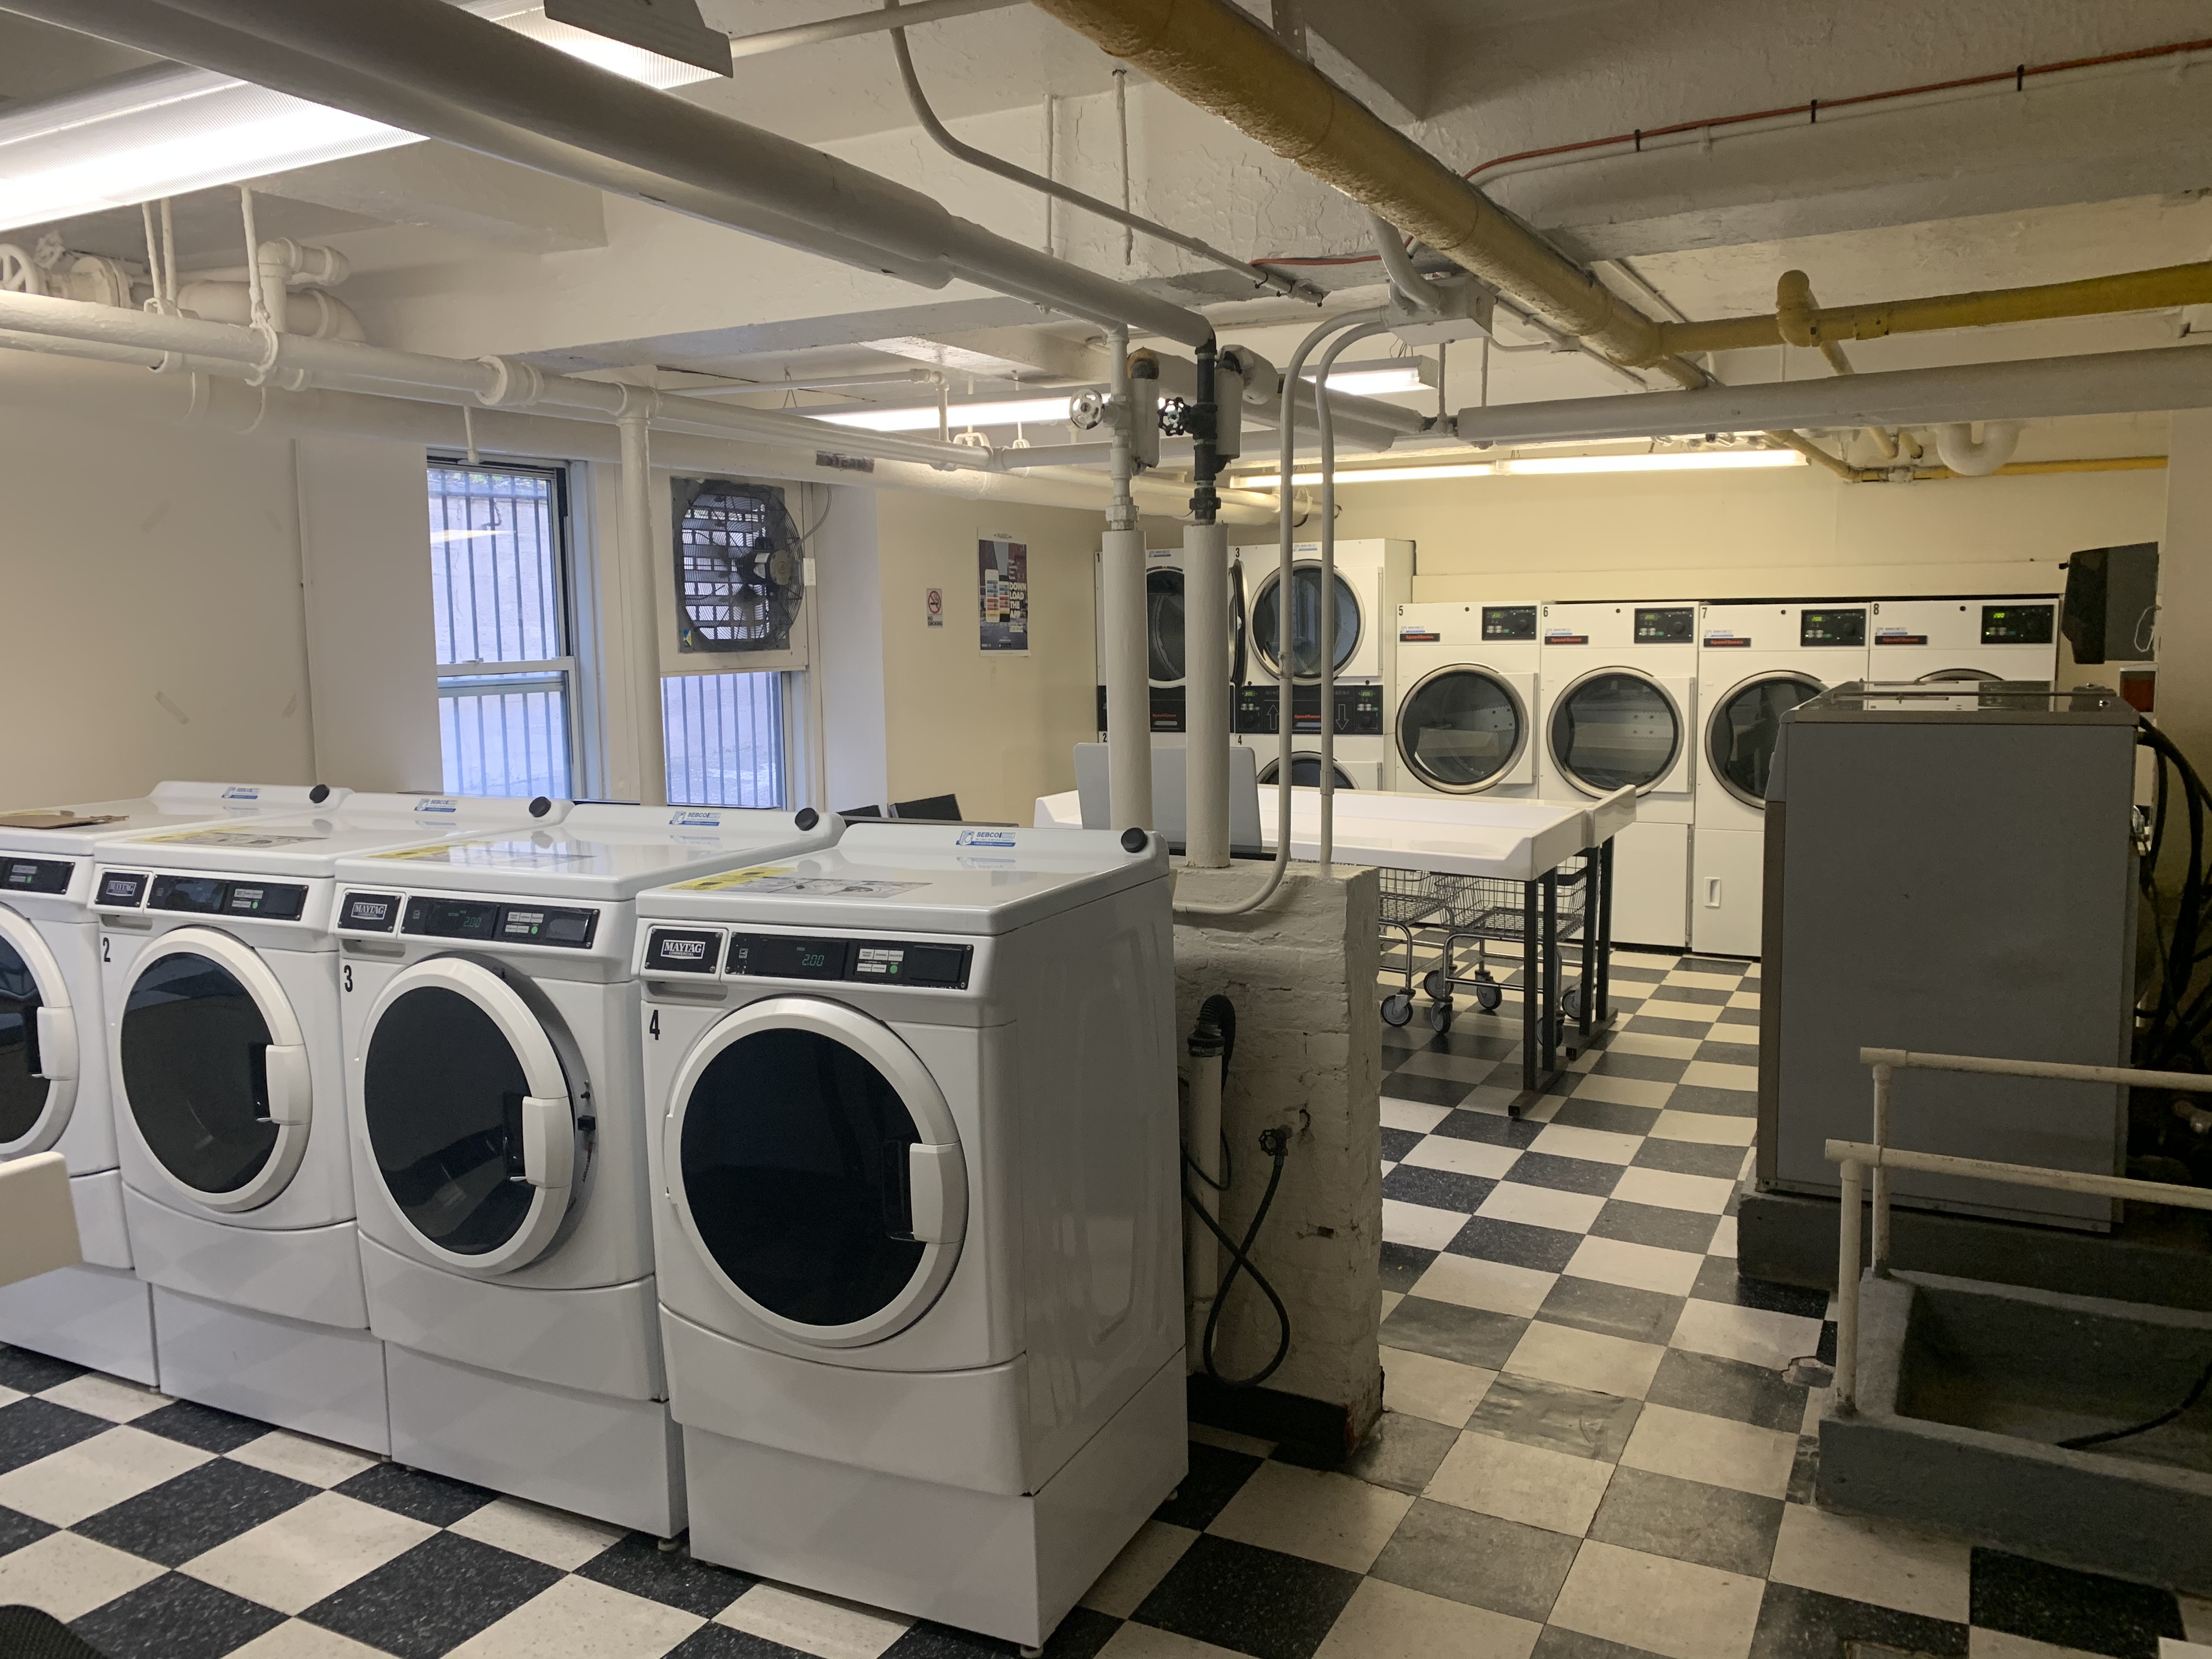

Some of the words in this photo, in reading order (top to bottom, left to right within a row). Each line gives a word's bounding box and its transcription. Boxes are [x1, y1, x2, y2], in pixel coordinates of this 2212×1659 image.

[1097, 552, 1100, 562] 1
[1235, 548, 1240, 557] 3
[1009, 582, 1026, 591] DOWN
[1009, 591, 1024, 600] LOAD
[1010, 601, 1020, 609] THE
[1399, 605, 1403, 616] 5
[1874, 603, 1880, 615] 8
[1010, 610, 1020, 619] APP
[1543, 606, 1548, 617] 6
[1702, 607, 1707, 618] 7
[1103, 733, 1107, 742] 2
[1238, 735, 1242, 745] 4
[353, 904, 384, 915] MAYTAG
[103, 937, 111, 962] 2
[664, 941, 702, 953] MAYTAG
[802, 954, 825, 967] 2.00
[343, 965, 353, 992] 3
[650, 1009, 660, 1040] 4
